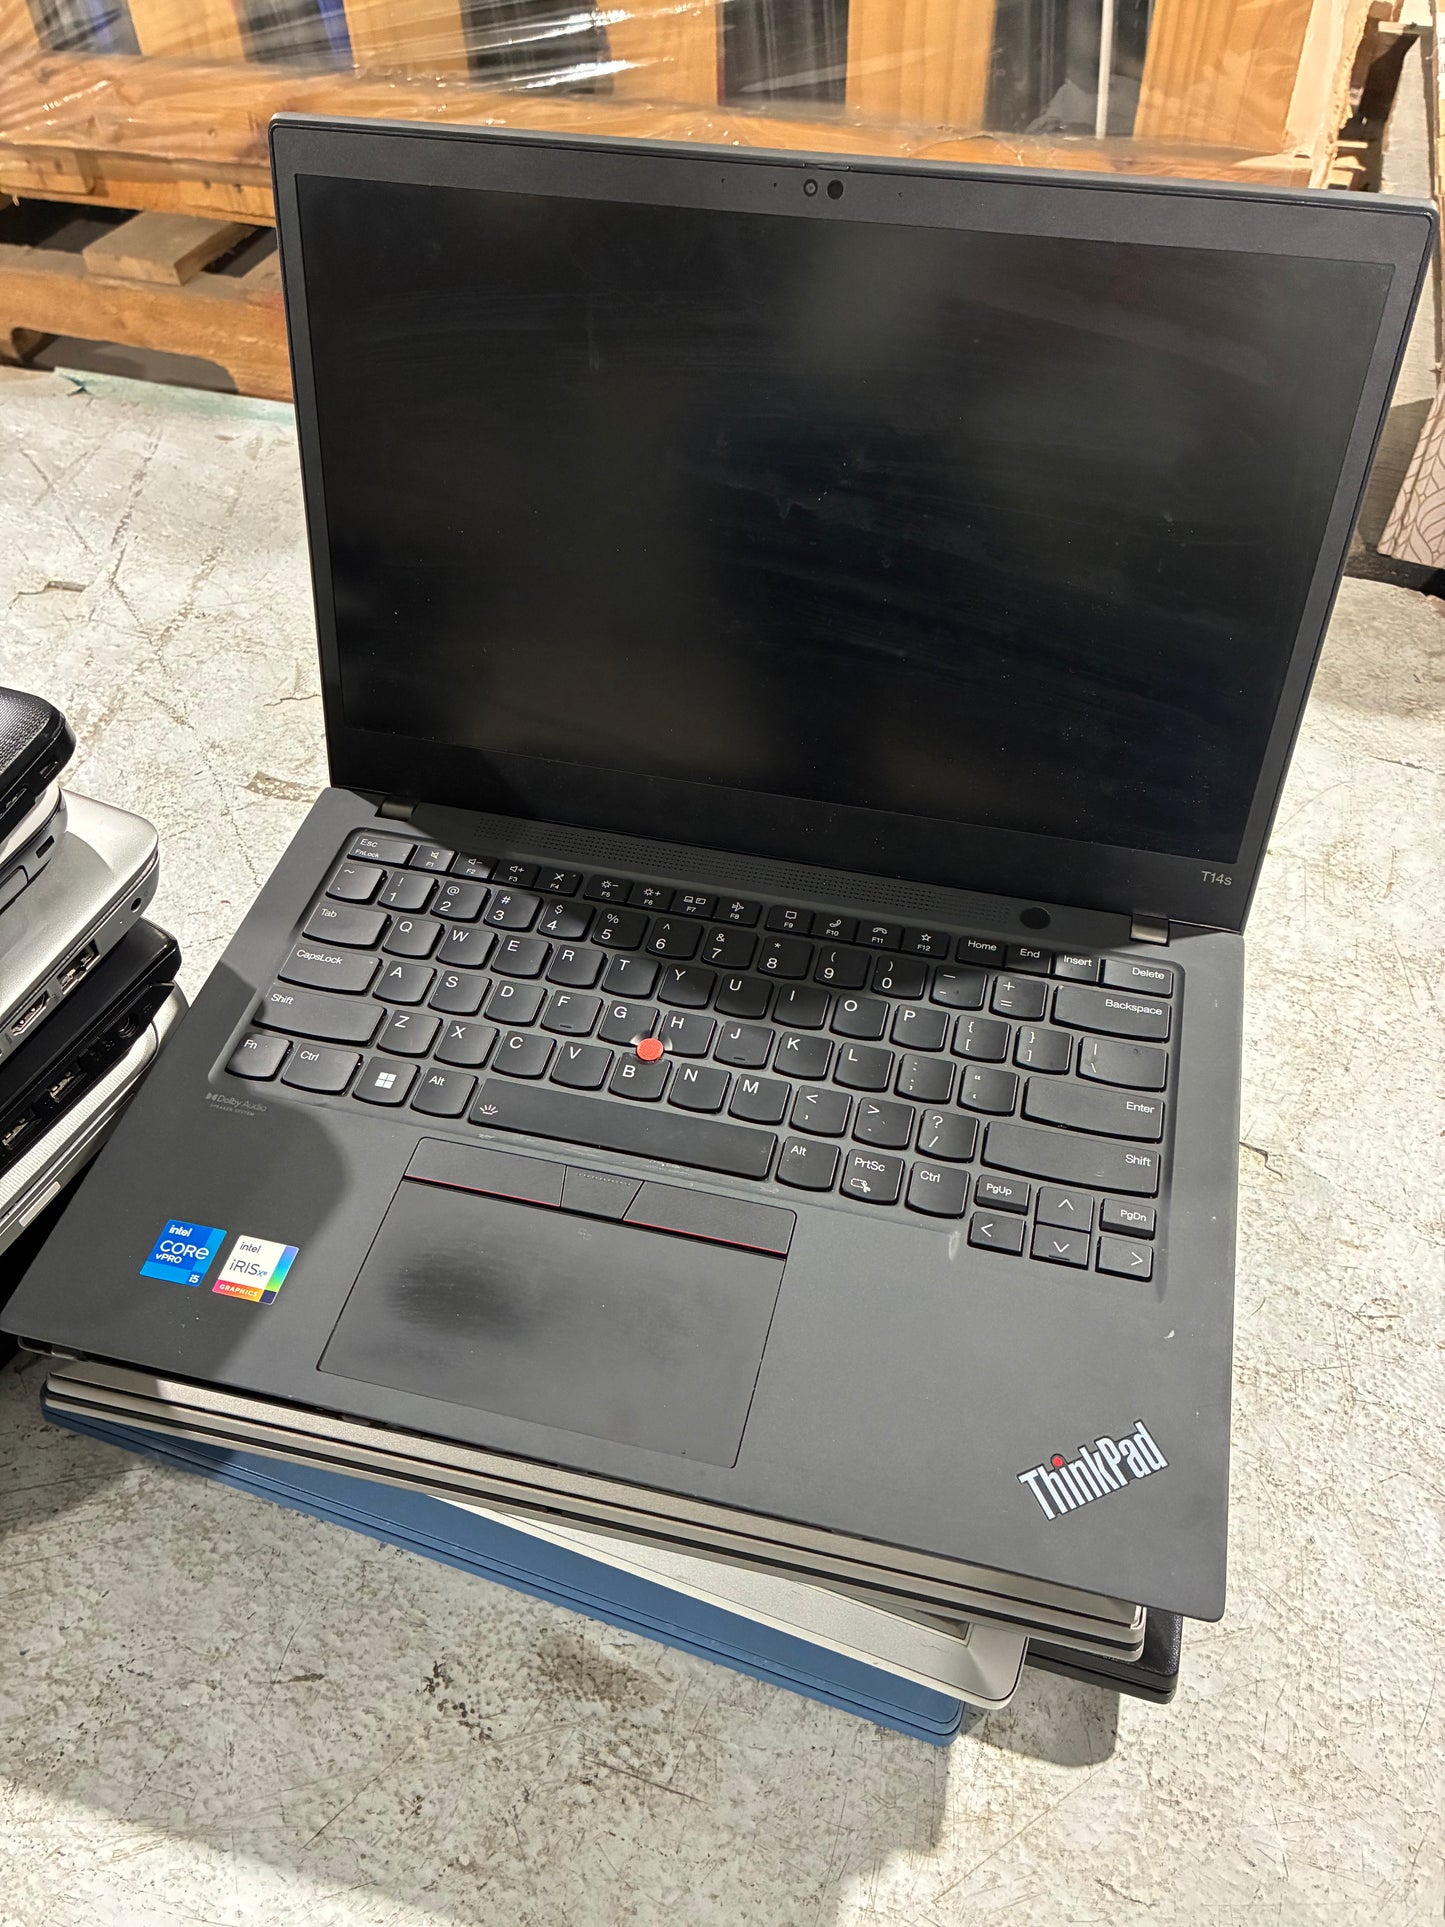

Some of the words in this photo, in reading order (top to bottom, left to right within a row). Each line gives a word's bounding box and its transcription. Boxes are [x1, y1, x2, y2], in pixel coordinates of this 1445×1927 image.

[360, 838, 378, 848] Esc
[355, 848, 379, 858] FnLock
[1201, 870, 1232, 886] T14s
[390, 892, 397, 902] 1
[321, 907, 338, 919] Tab
[440, 901, 452, 912] 2
[493, 910, 505, 921] 3
[400, 921, 413, 934] Q
[547, 920, 557, 931] 4
[783, 921, 794, 929] F9
[452, 929, 470, 942] W
[601, 929, 613, 940] 5
[826, 929, 840, 937] F10
[507, 940, 521, 952] E
[655, 938, 666, 949] 6
[871, 936, 884, 944] F11
[967, 940, 997, 951] Home
[296, 949, 343, 965] CapsLock
[561, 949, 575, 962] R
[711, 948, 722, 959] 7
[1020, 948, 1041, 959] End
[619, 959, 630, 971] T
[766, 957, 778, 969] 8
[1063, 955, 1093, 967] Insert
[390, 966, 403, 979] A
[674, 969, 686, 981] Y
[823, 967, 835, 979] 9
[1132, 967, 1165, 980] Delete
[445, 976, 459, 988] S
[729, 978, 743, 991] U
[881, 977, 893, 989] 0
[500, 985, 515, 998] D
[270, 993, 294, 1005] Shift
[557, 995, 571, 1007] F
[844, 999, 858, 1012] O
[613, 1006, 628, 1019] G
[1105, 999, 1163, 1016] Backspace
[394, 1015, 410, 1028] Z
[903, 1010, 916, 1021] P
[670, 1016, 685, 1029] H
[450, 1025, 467, 1039] X
[730, 1028, 742, 1040] J
[243, 1039, 258, 1050] Fn
[509, 1036, 524, 1049] C
[787, 1037, 801, 1051] K
[300, 1050, 320, 1062] Ctrl
[569, 1046, 582, 1060] V
[848, 1049, 858, 1062] L
[622, 1064, 636, 1078] B
[684, 1068, 699, 1082] N
[429, 1075, 446, 1087] Alt
[743, 1080, 760, 1094] M
[217, 1095, 242, 1108] Dolby
[242, 1100, 267, 1112] Audio
[1126, 1101, 1155, 1114] Enter
[932, 1115, 944, 1129] ?
[790, 1145, 807, 1157] Alt
[854, 1157, 886, 1172] PrtSc
[1125, 1154, 1151, 1167] Shift
[920, 1170, 941, 1183] Ctrl
[986, 1183, 1013, 1196] PgUp
[1120, 1209, 1147, 1222] PgDn
[169, 1224, 193, 1238] intel
[240, 1241, 262, 1254] intel
[155, 1253, 183, 1264] vPRO
[188, 1274, 200, 1284] i5
[219, 1283, 259, 1298] GRAPHICS
[1018, 1420, 1169, 1520] ThinkPad
